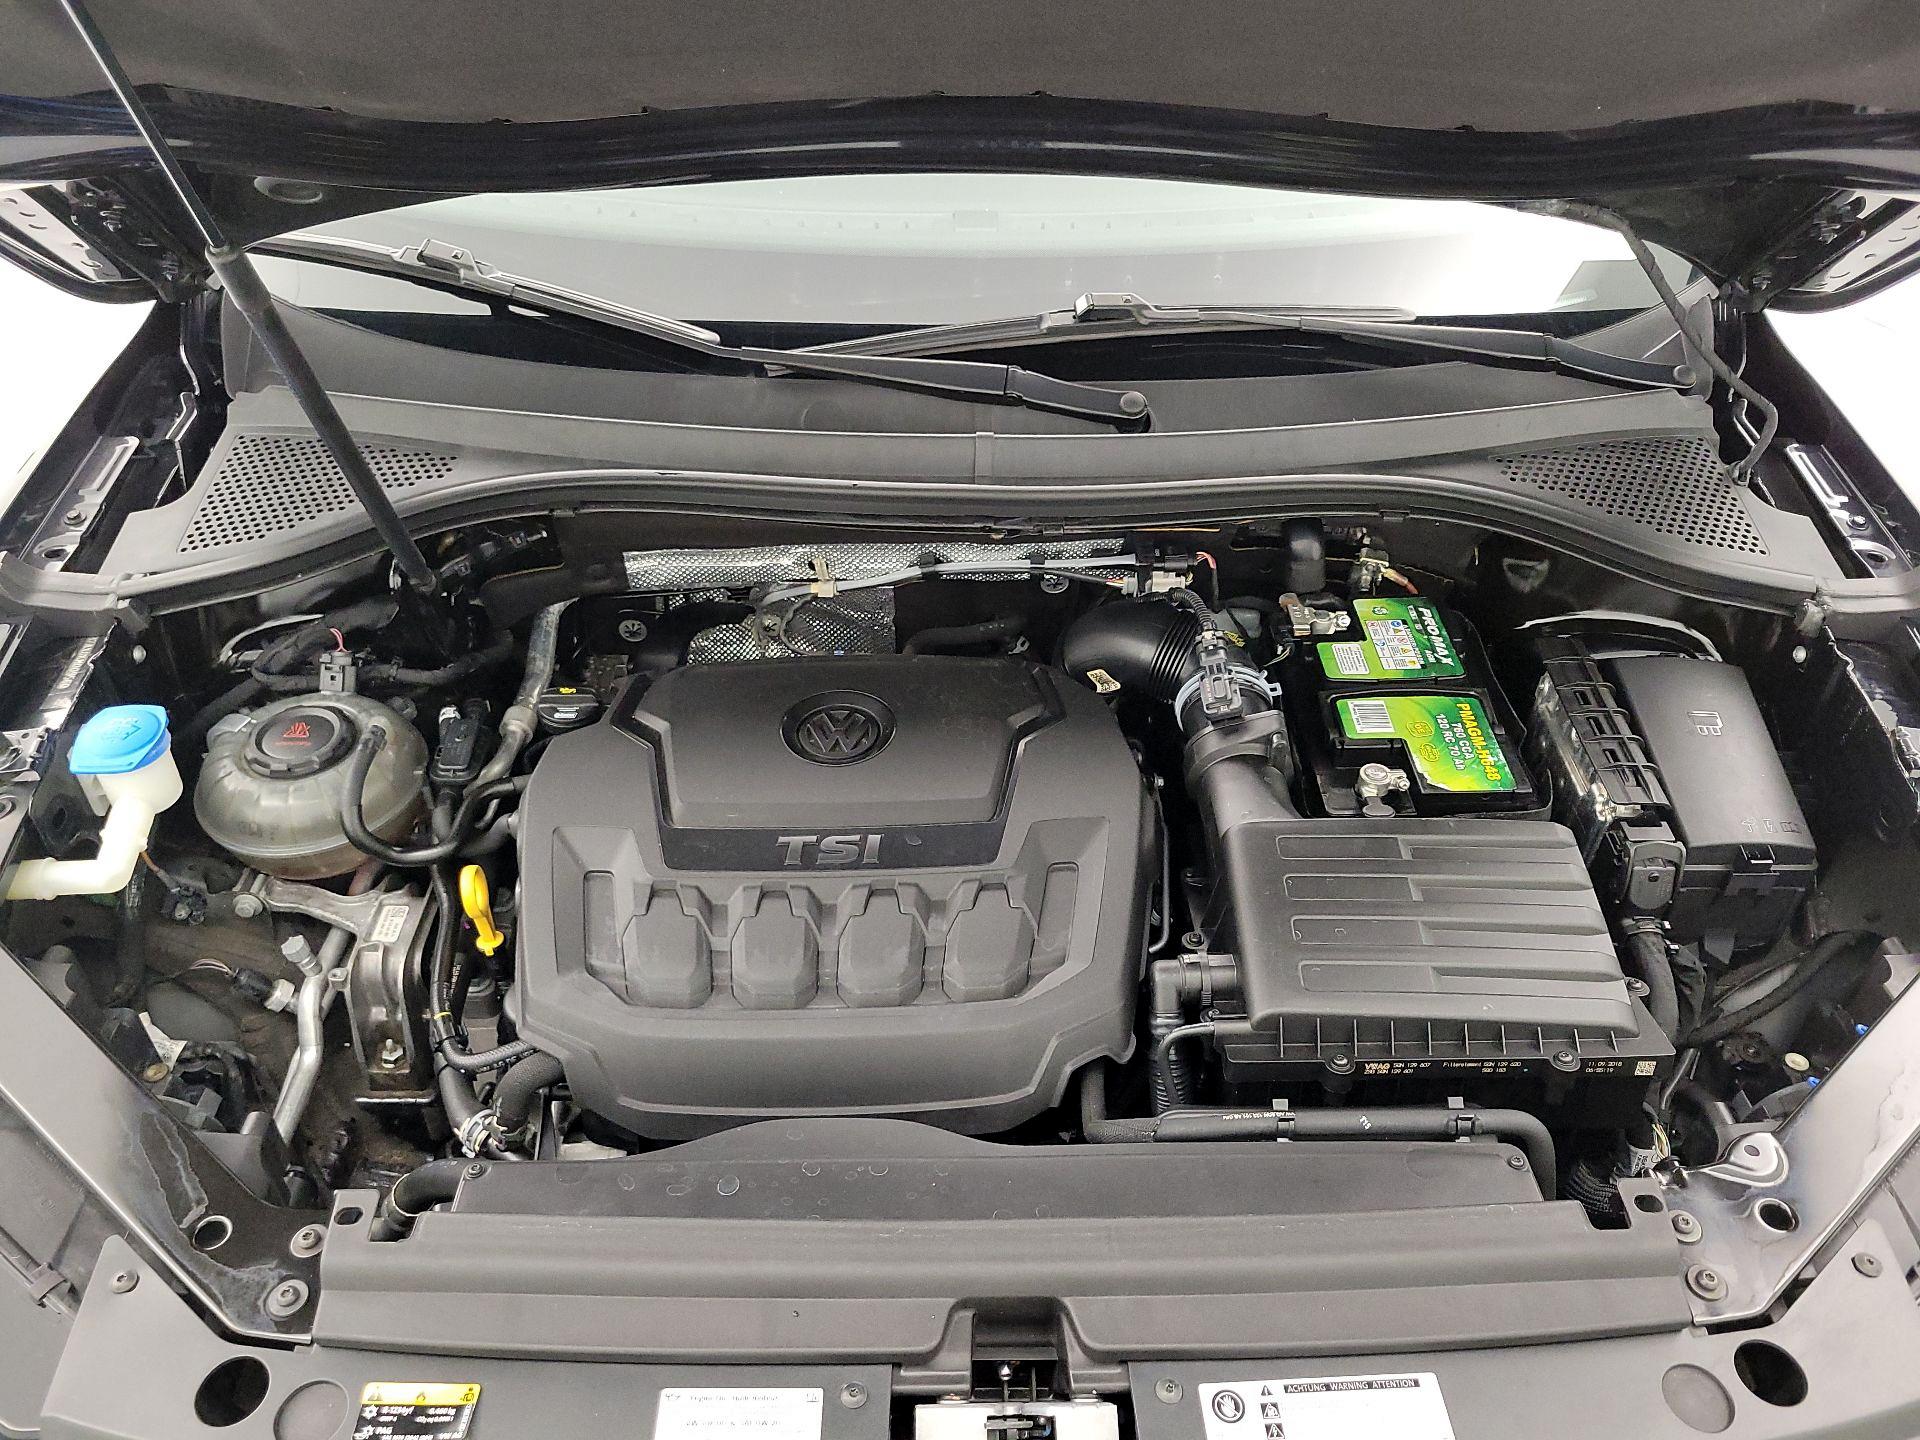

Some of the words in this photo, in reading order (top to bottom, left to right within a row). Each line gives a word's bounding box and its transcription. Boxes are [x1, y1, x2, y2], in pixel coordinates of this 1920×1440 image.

[1418, 606, 1455, 667] PROMAX
[1435, 713, 1451, 729] 120
[1441, 730, 1457, 743] RC
[1450, 722, 1466, 738] 760
[1459, 740, 1475, 760] CCA
[1447, 746, 1461, 757] 70
[1451, 758, 1465, 770] Ah
[776, 834, 884, 865] TSI
[1287, 1382, 1326, 1393] ACHTUNG
[1329, 1380, 1369, 1391] WARNING
[1372, 1378, 1415, 1389] ATTENTION
